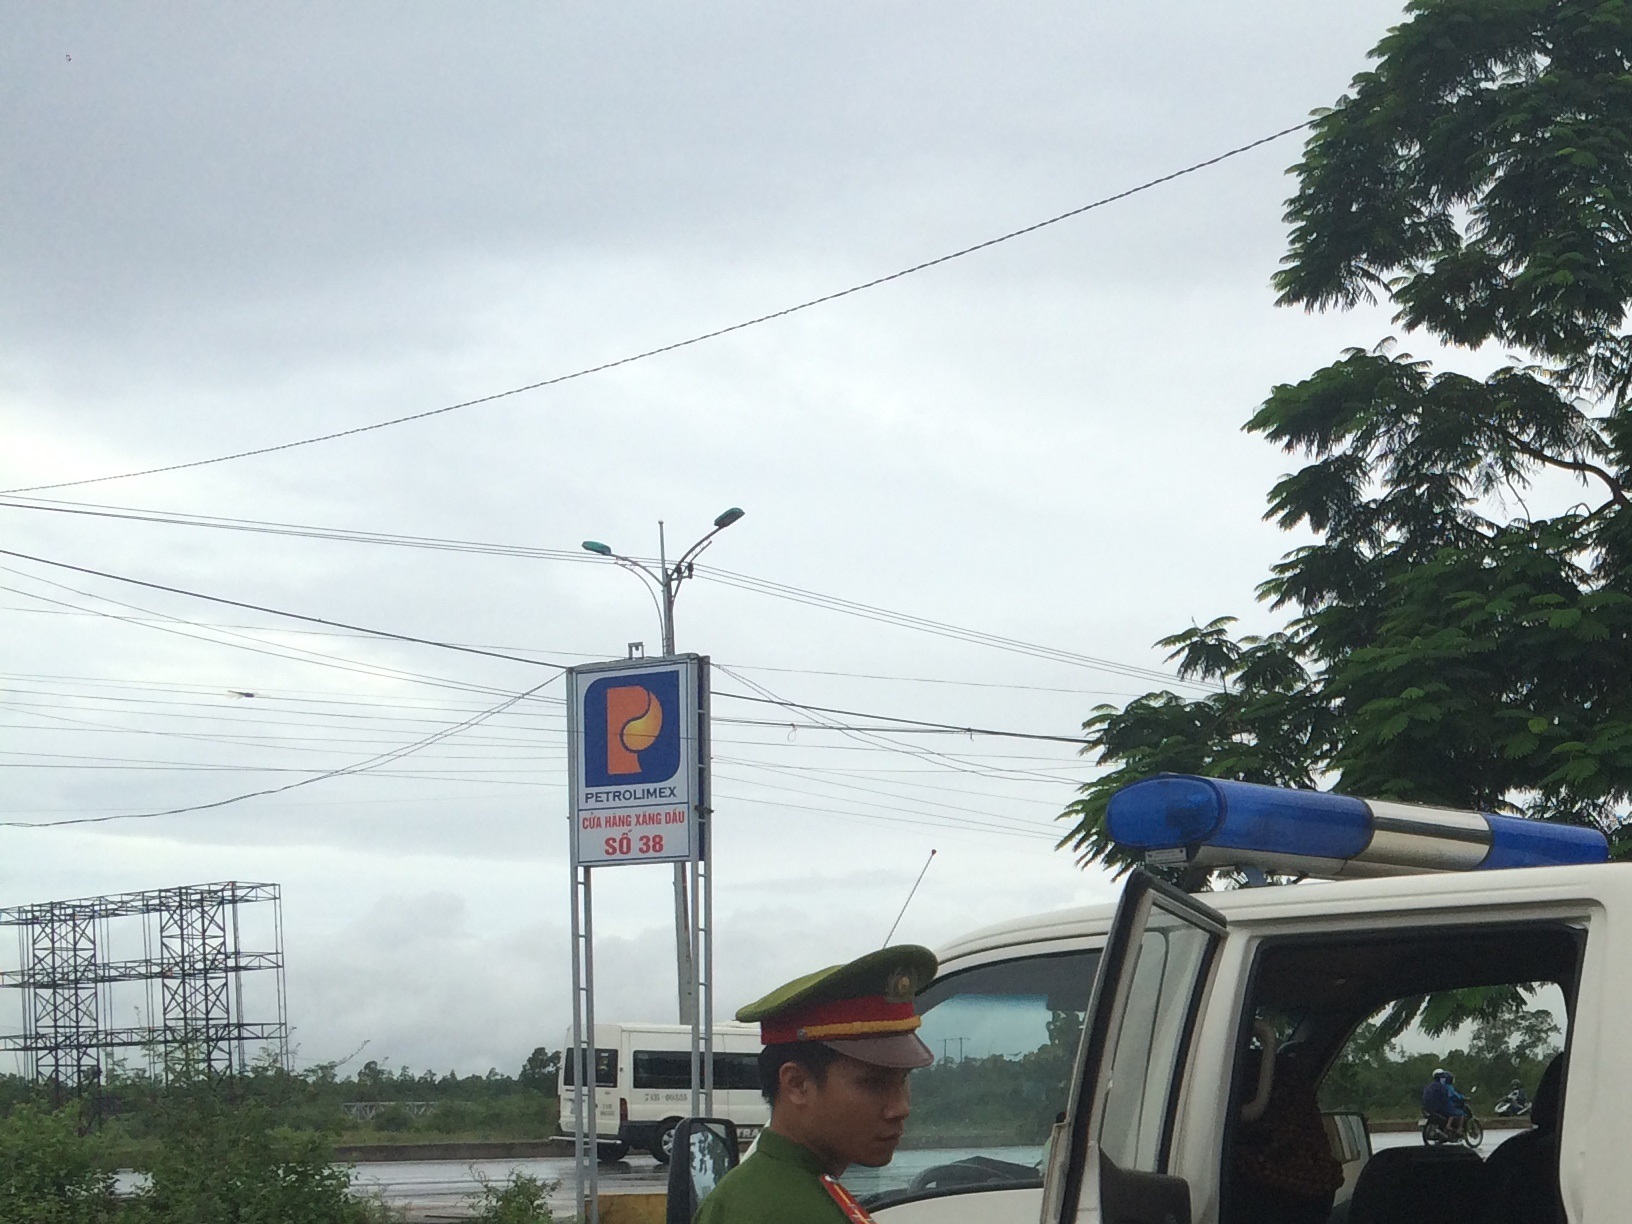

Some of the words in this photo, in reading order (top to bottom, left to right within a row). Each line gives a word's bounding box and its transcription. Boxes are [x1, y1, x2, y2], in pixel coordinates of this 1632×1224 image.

[585, 787, 677, 803] PETROLIMEX
[605, 813, 632, 828] HÀNG
[604, 829, 632, 856] SỐ
[639, 834, 664, 853] 38
